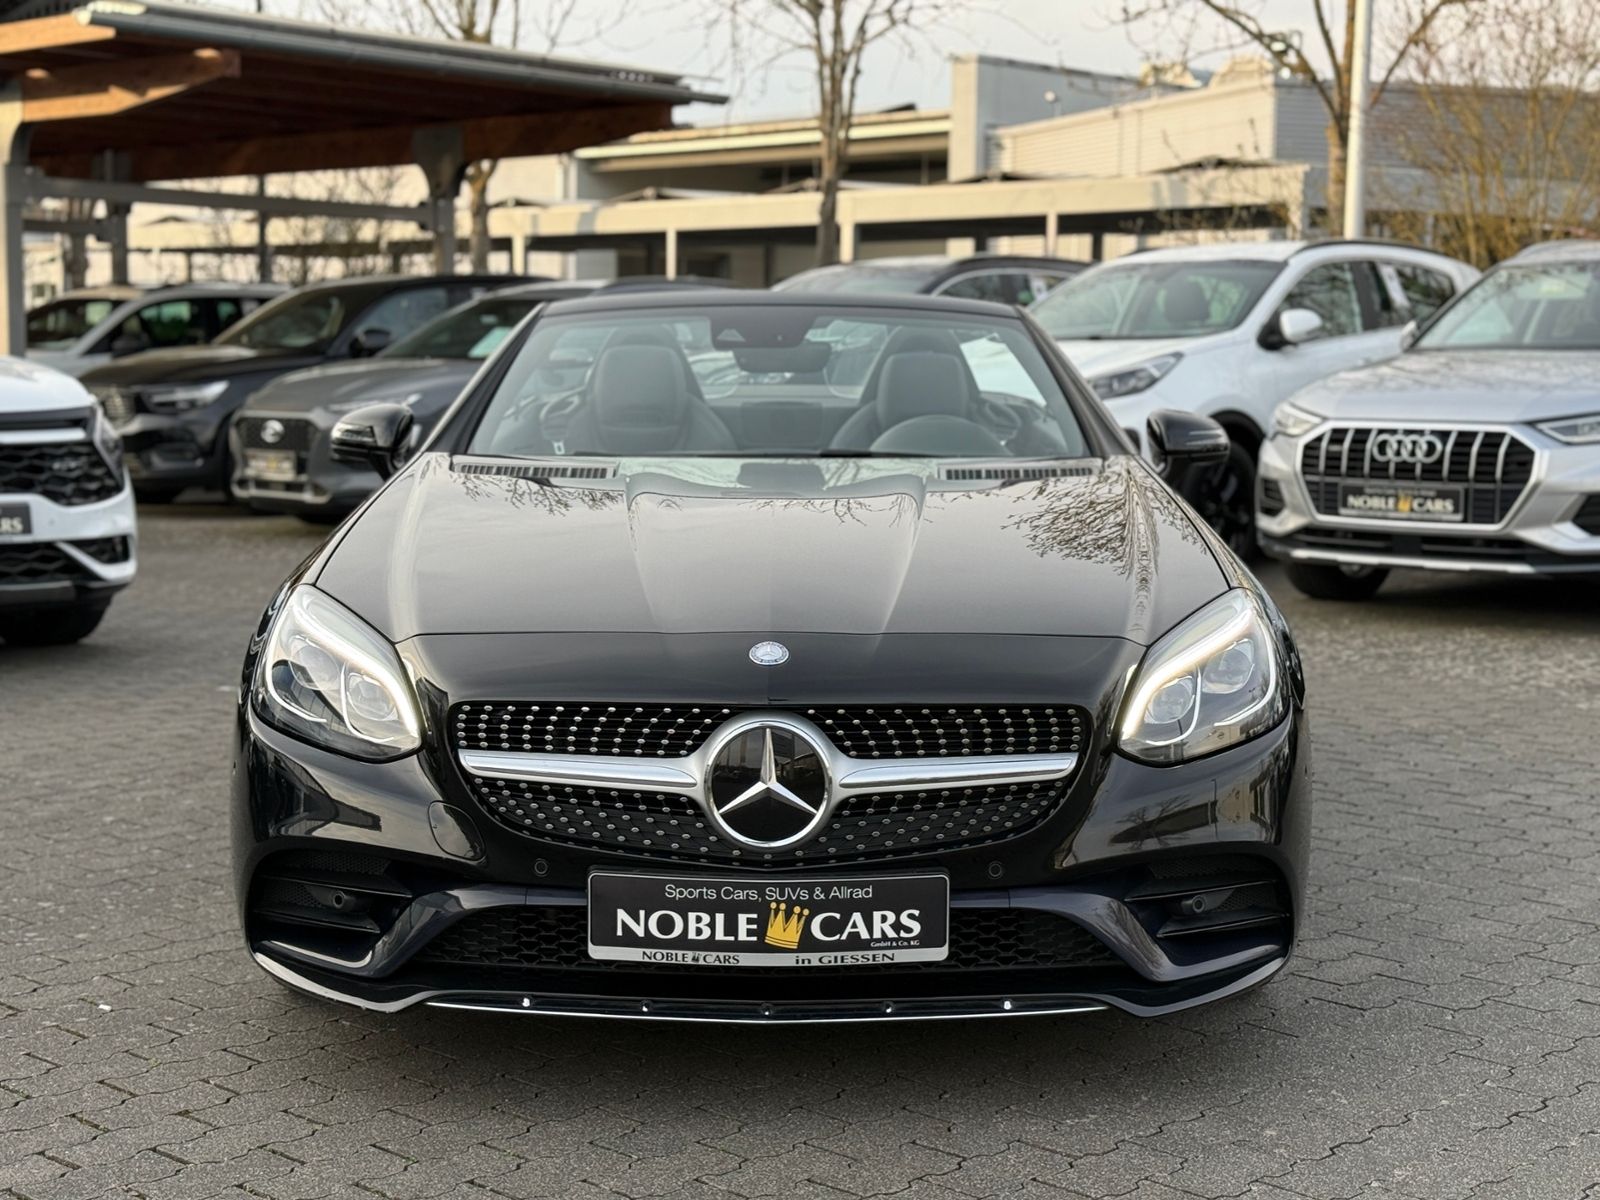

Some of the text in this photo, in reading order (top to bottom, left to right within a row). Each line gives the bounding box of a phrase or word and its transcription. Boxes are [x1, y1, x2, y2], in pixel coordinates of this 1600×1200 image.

[1346, 494, 1454, 513] NOBLE CARS
[0, 516, 23, 533] RS
[664, 884, 873, 902] Sports Cars, SUVs & Allrad
[616, 908, 922, 941] NOBLE CARS
[870, 940, 891, 948] GmbH
[642, 950, 740, 965] NOBLE CARS
[795, 952, 895, 965] in GIESSEN
